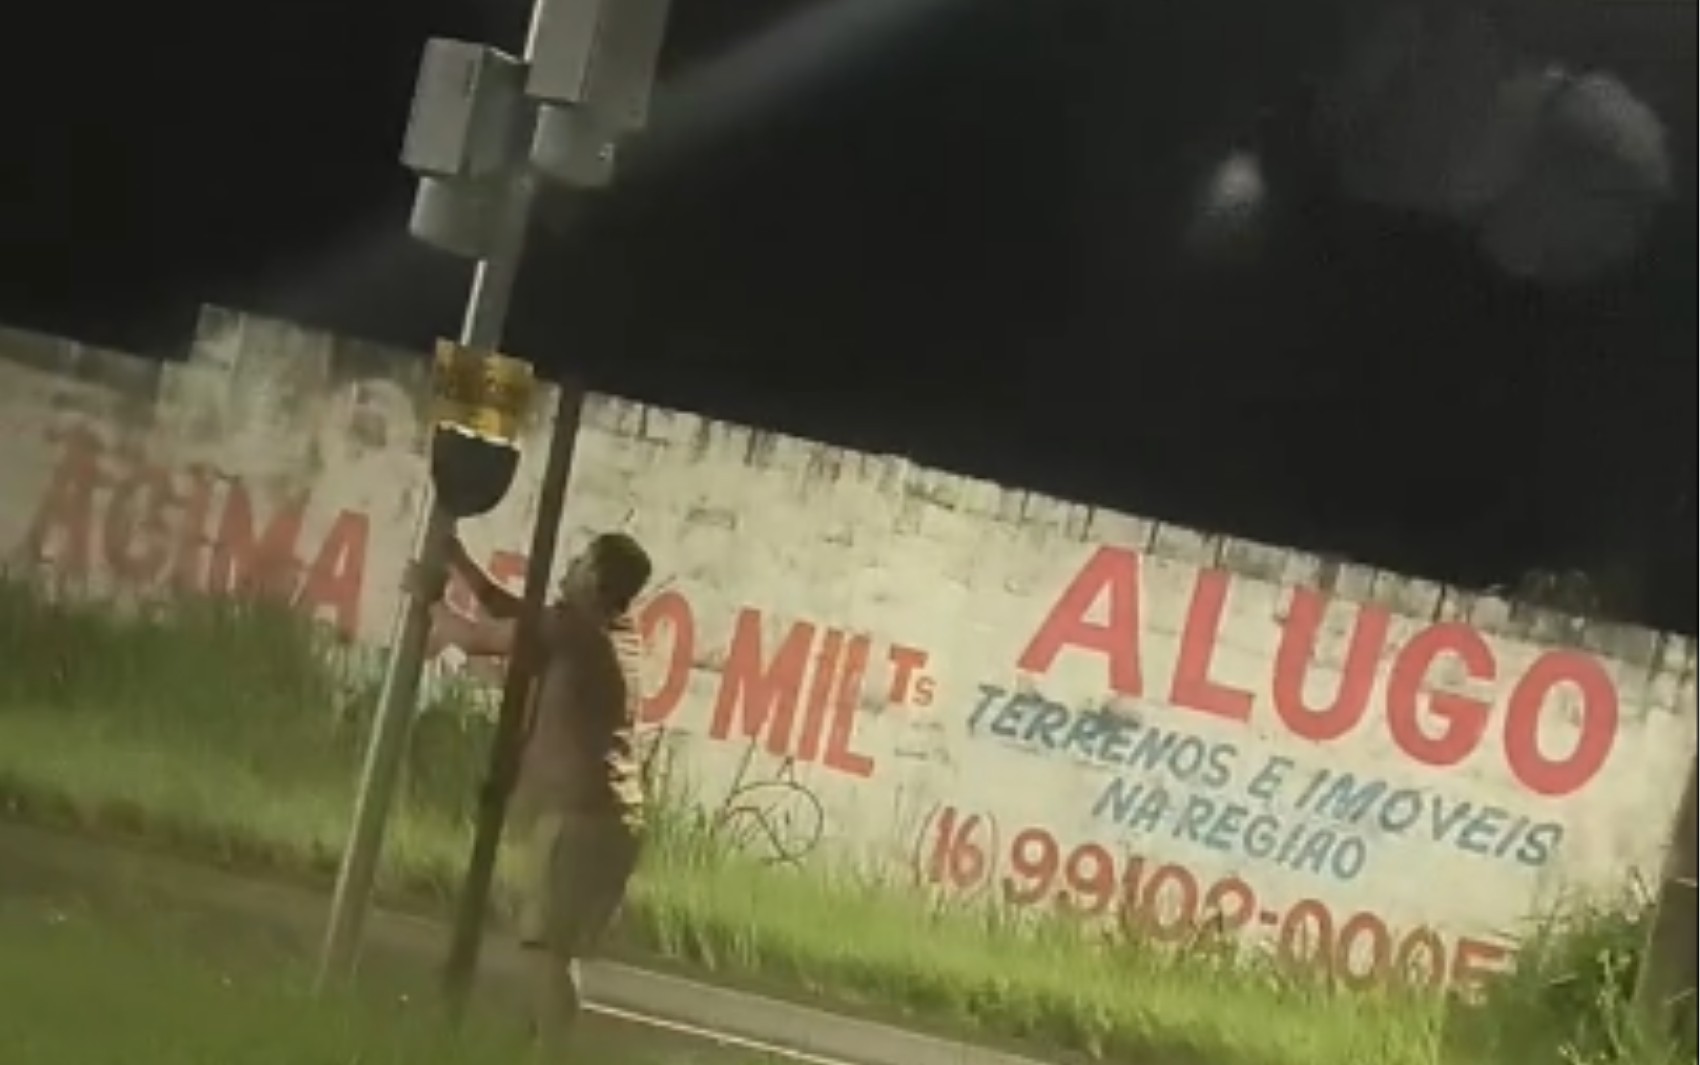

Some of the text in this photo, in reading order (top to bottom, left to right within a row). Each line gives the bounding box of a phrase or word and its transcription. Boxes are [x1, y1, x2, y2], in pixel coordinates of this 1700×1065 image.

[708, 606, 875, 779] MIL
[967, 683, 1239, 788] TERRENOS
[1247, 755, 1295, 800] E
[1016, 544, 1620, 795] ALUGO
